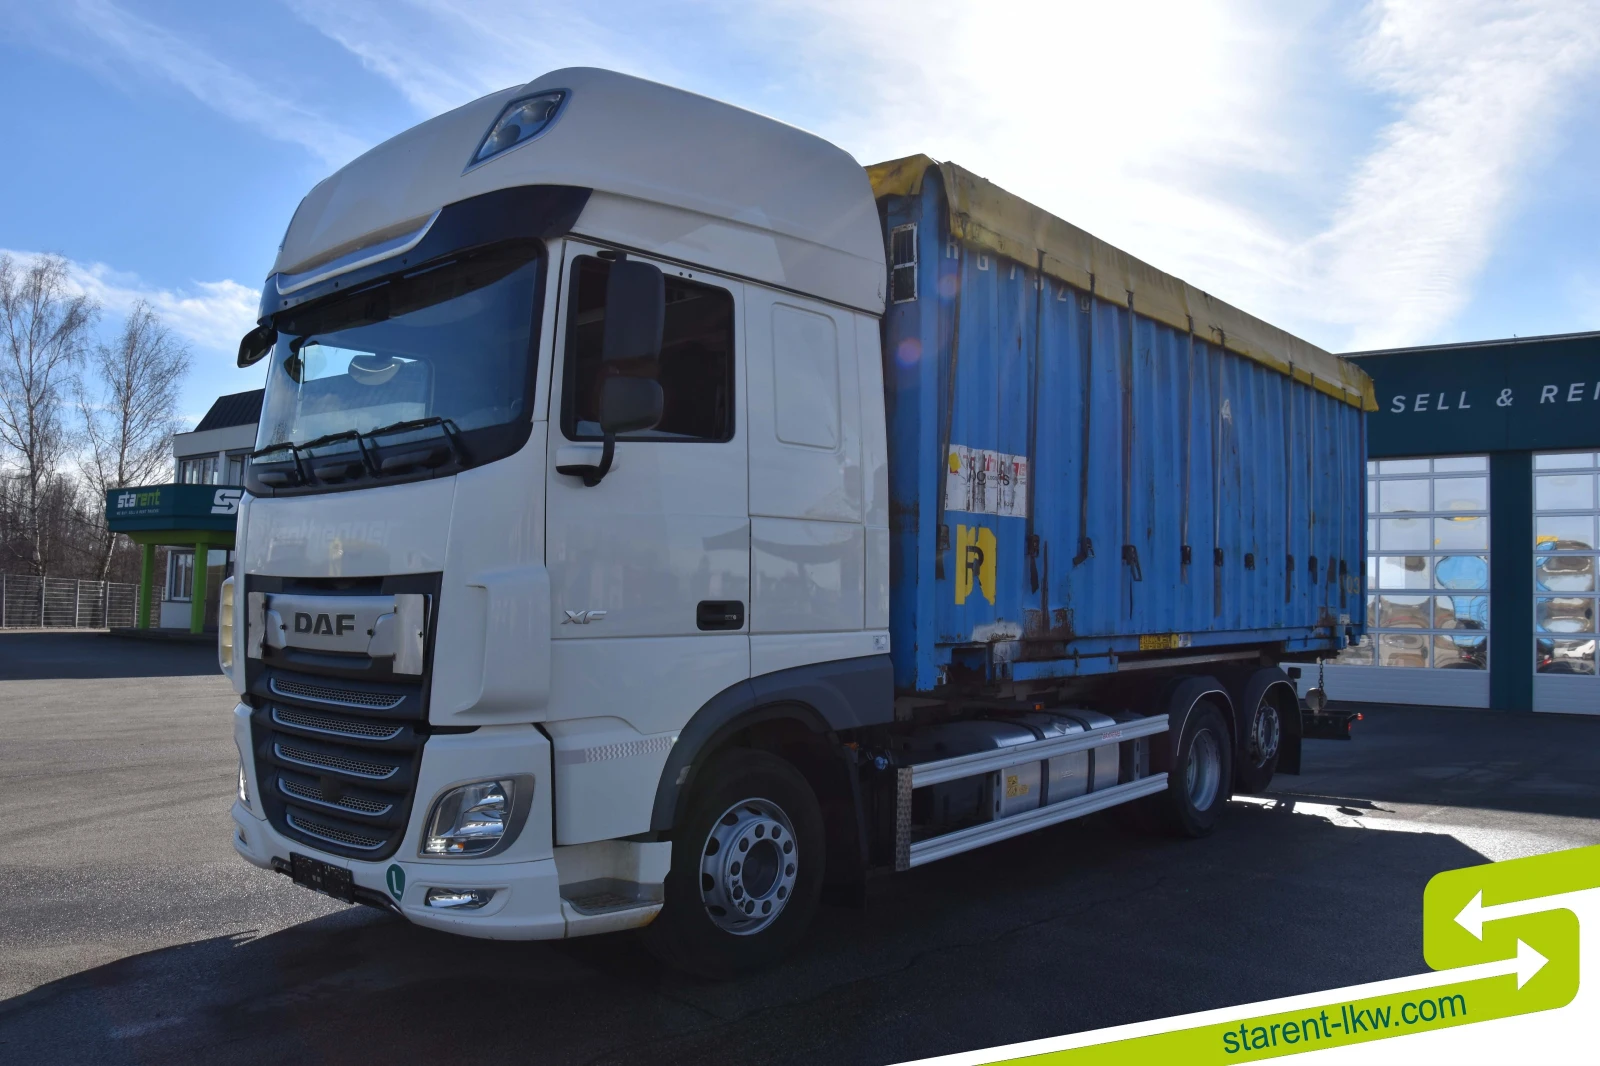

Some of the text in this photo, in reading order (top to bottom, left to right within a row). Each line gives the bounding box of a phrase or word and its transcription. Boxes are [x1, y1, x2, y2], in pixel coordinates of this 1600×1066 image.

[1391, 391, 1471, 413] SELL
[1496, 388, 1514, 407] &
[117, 489, 161, 509] starent
[294, 612, 356, 636] DAF
[561, 611, 607, 625] XF
[391, 870, 401, 896] L
